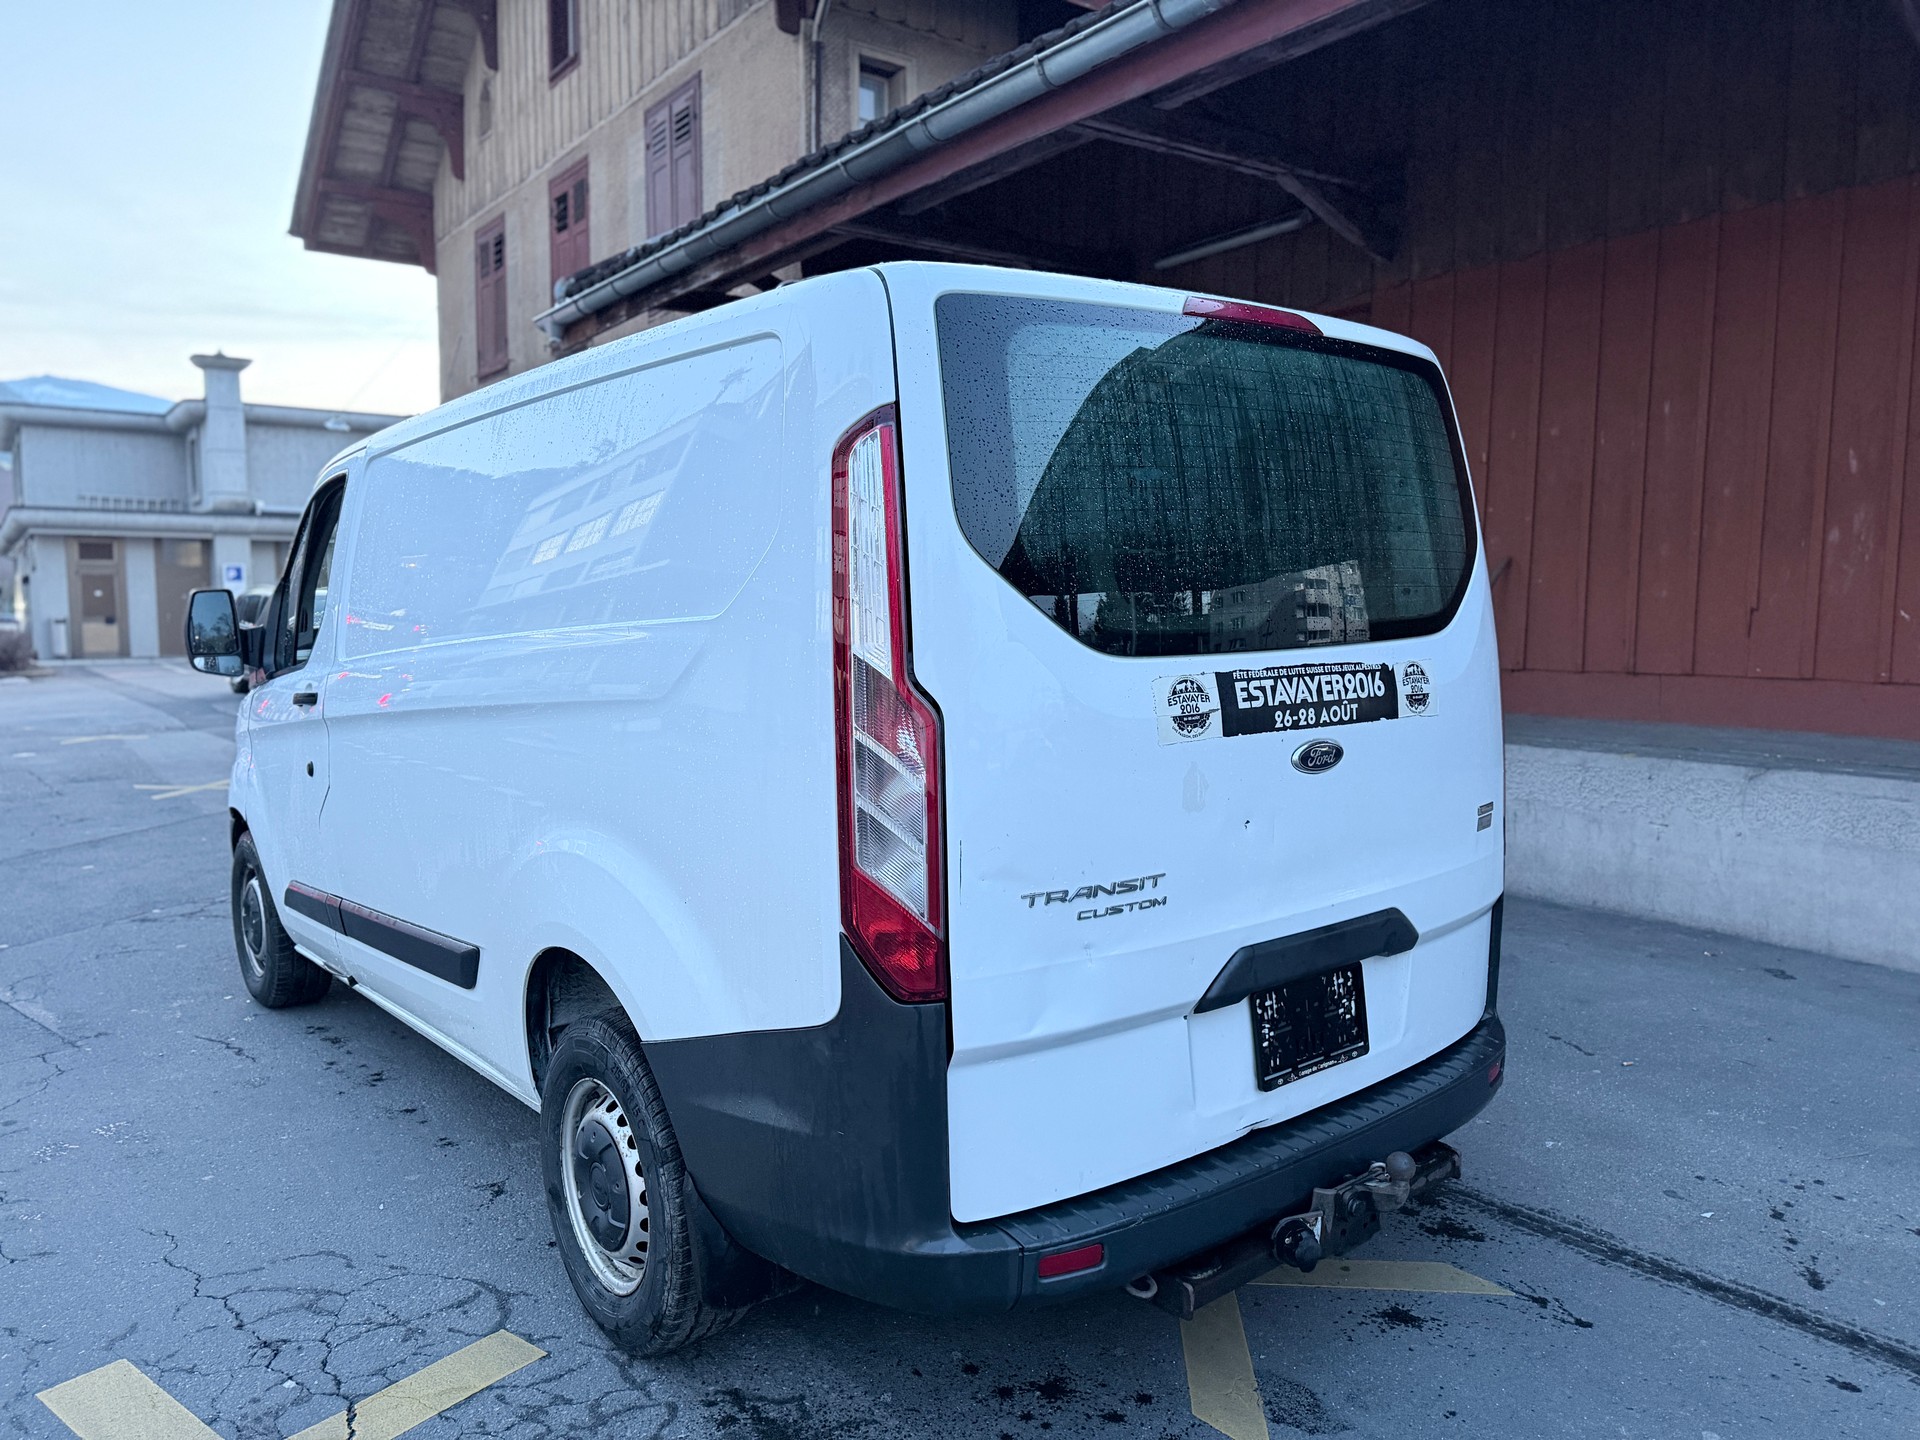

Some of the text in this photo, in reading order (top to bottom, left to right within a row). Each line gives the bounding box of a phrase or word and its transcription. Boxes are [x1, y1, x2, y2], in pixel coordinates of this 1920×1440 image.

[1279, 668, 1288, 676] DE
[1288, 667, 1306, 675] LUTTE
[1306, 665, 1324, 674] SUISSE
[1324, 665, 1331, 673] ET
[1331, 664, 1342, 672] DES
[1167, 693, 1211, 707] ESTAVAYER
[1180, 703, 1201, 714] 2016
[1274, 700, 1358, 728] 26-28 AOÛT
[1020, 872, 1166, 909] TRANSIT
[1076, 896, 1168, 921] CUSTOM
